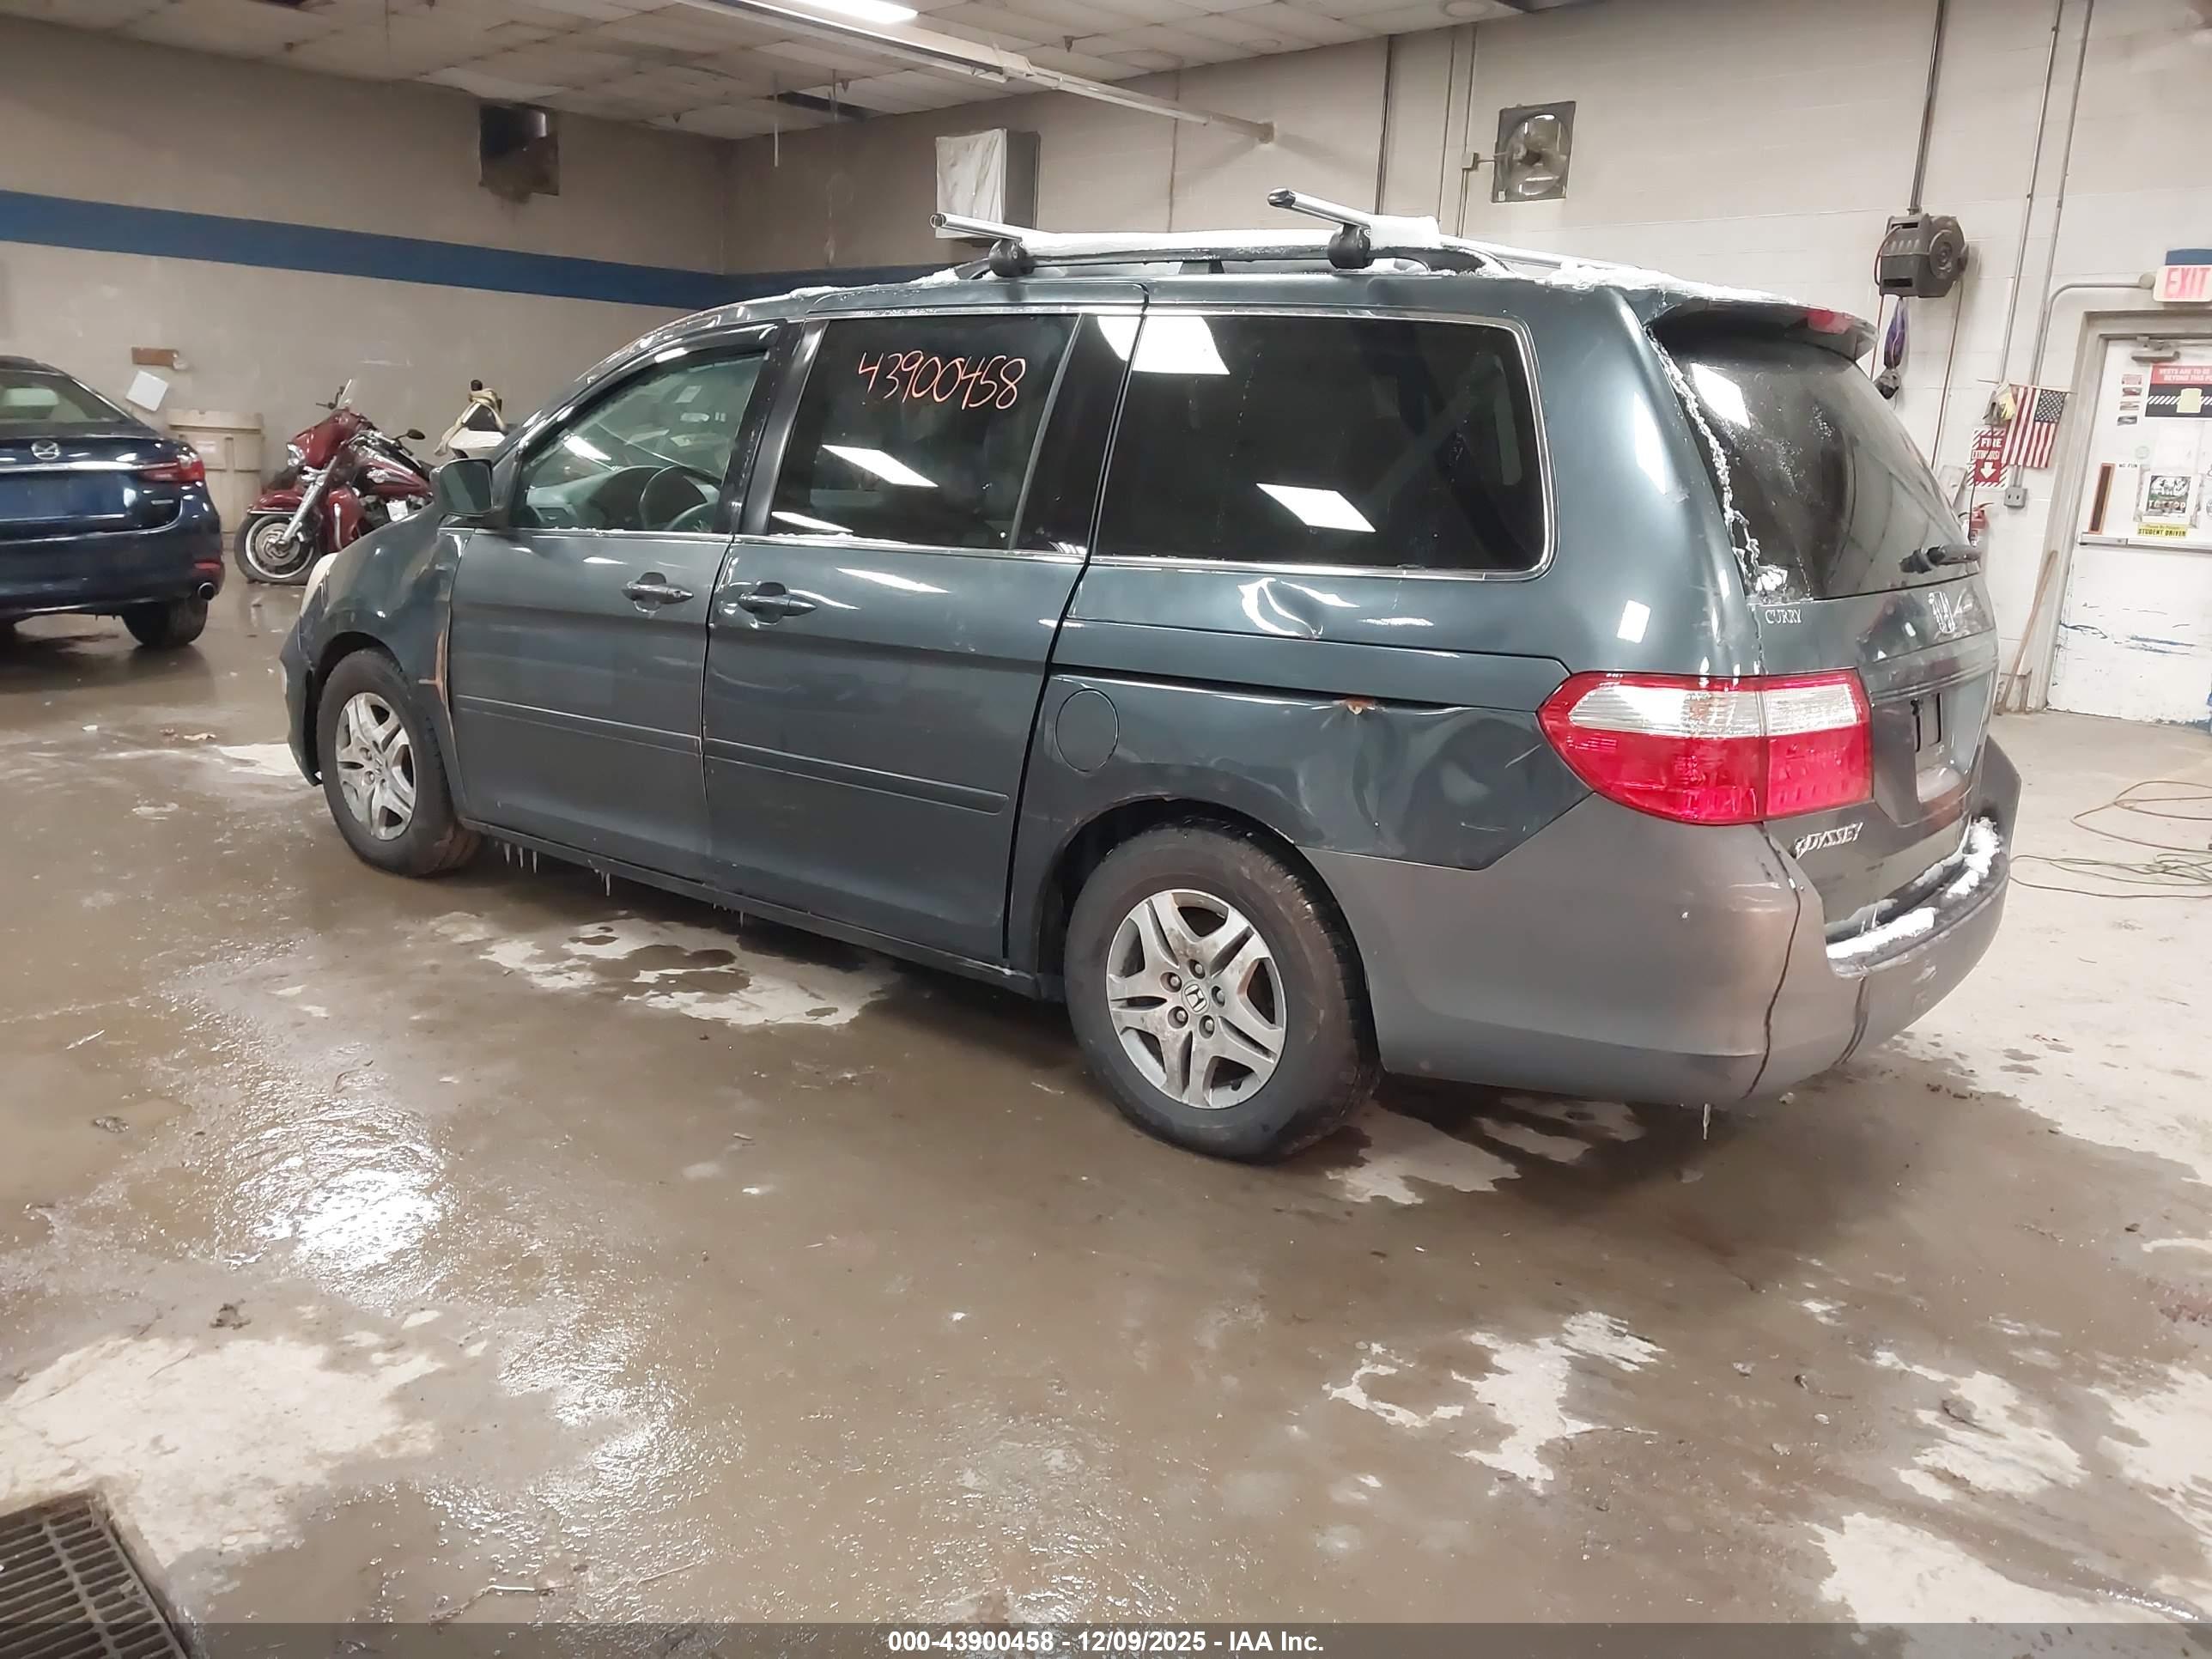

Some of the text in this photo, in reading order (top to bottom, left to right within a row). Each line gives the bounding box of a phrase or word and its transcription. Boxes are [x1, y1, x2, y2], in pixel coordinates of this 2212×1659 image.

[2165, 267, 2211, 298] EXIT
[859, 350, 1026, 410] 43900458
[1765, 609, 1802, 624] CURRY
